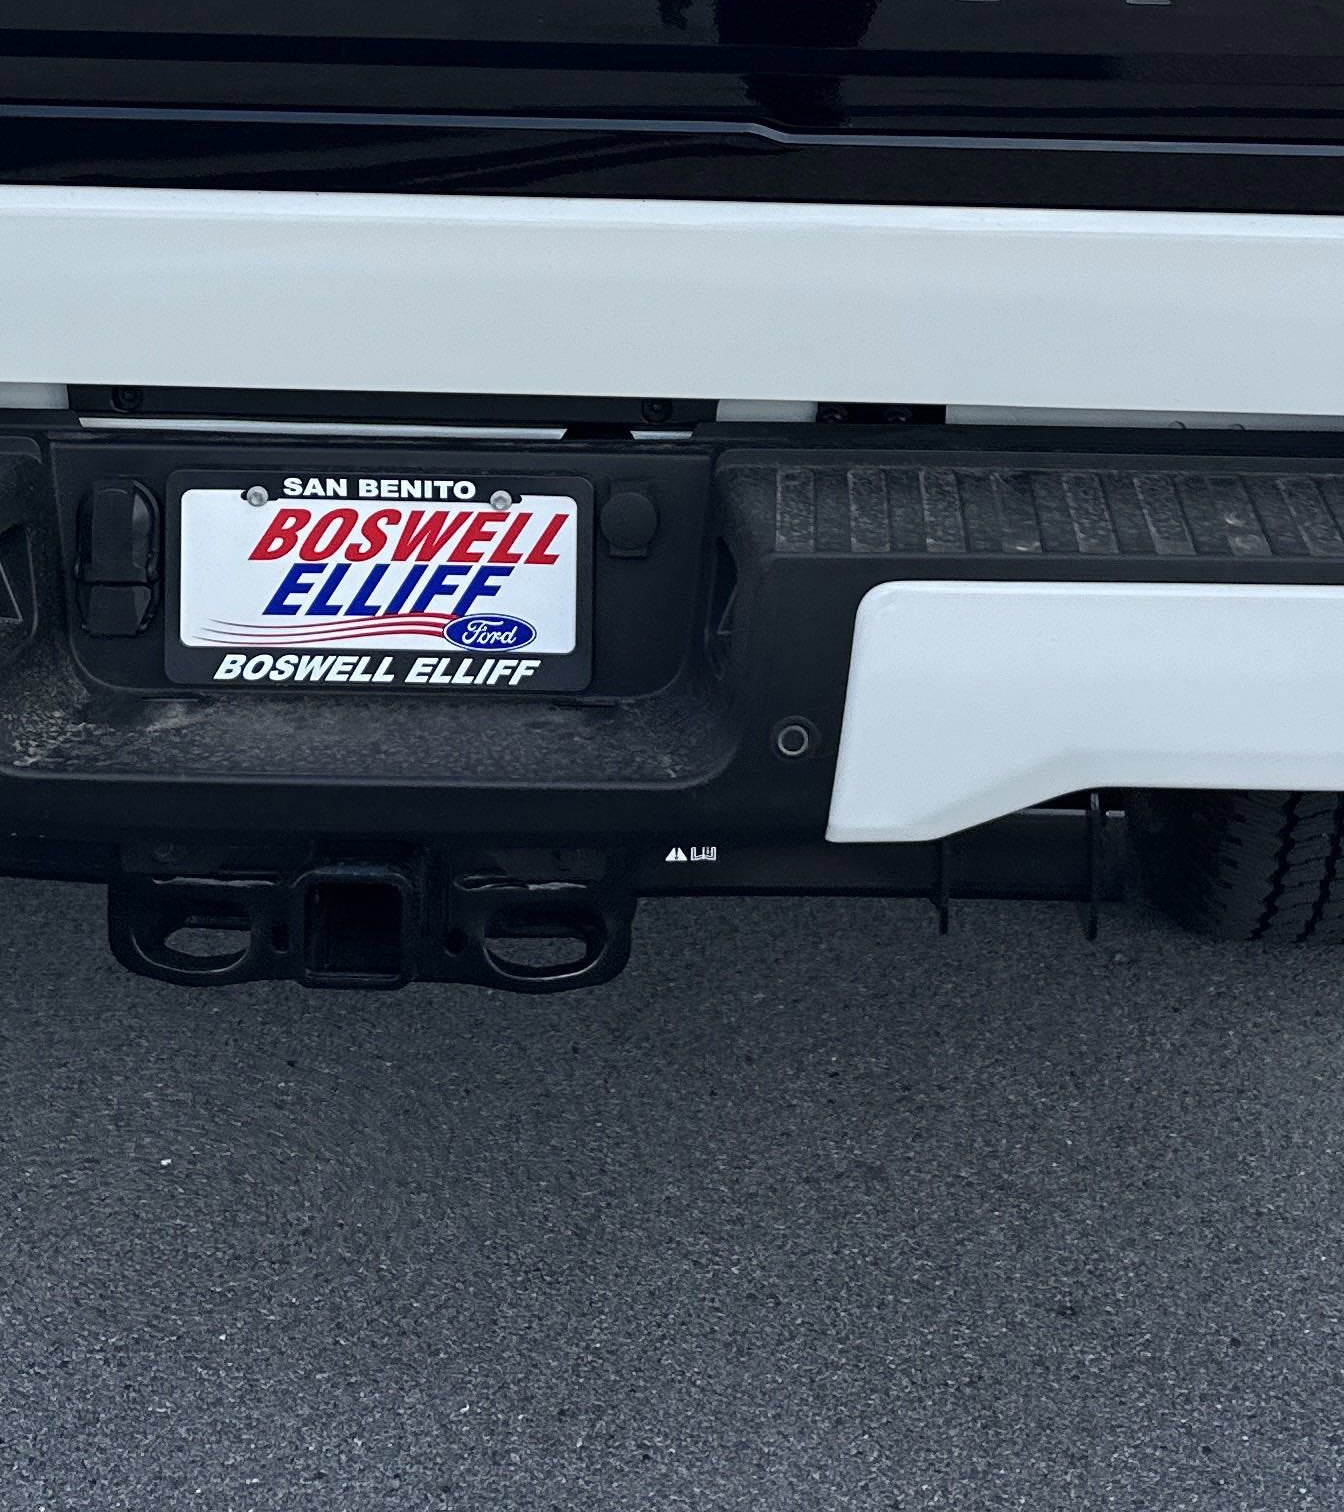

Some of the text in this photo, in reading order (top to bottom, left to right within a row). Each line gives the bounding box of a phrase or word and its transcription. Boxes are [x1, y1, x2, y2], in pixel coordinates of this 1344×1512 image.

[282, 477, 477, 501] SAN BENITO
[248, 508, 569, 565] BOSWELL
[262, 563, 516, 617] ELLIFF
[461, 618, 517, 645] Ford
[213, 653, 541, 687] BOSWELL ELLIFF
